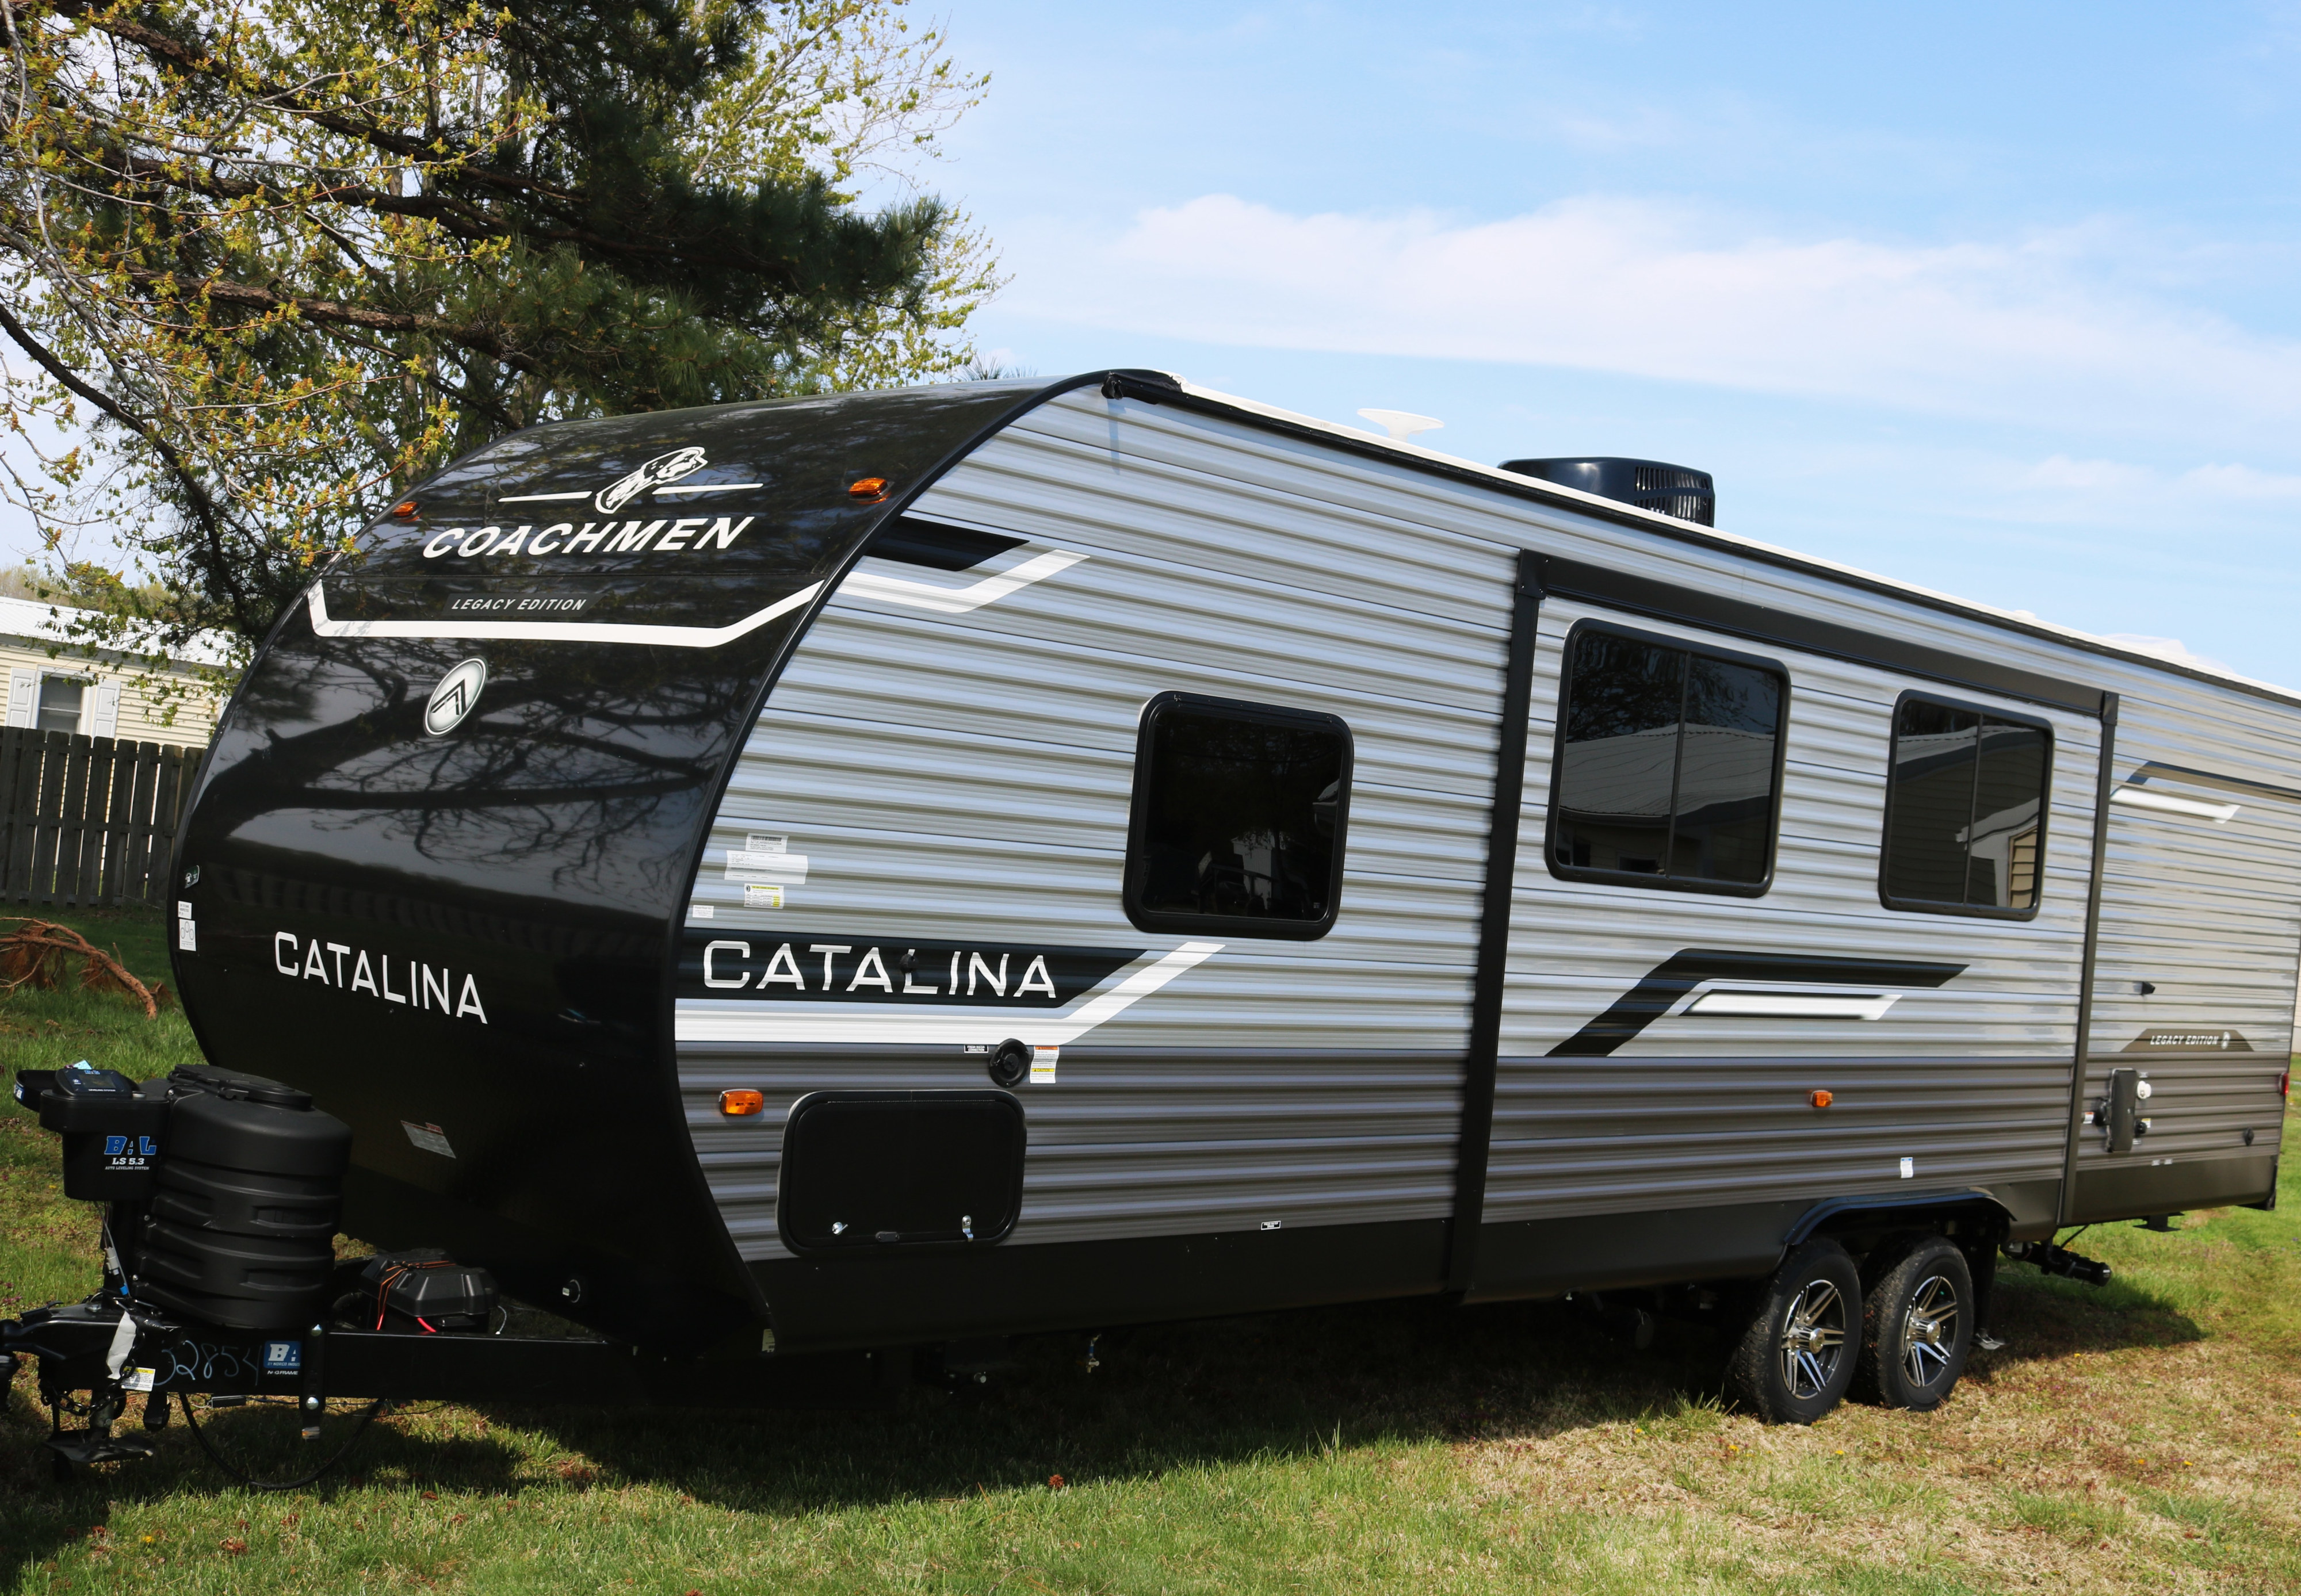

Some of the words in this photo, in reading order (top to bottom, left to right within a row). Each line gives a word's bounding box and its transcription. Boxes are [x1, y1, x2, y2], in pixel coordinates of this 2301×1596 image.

[422, 516, 755, 558] COACHMEN
[452, 599, 515, 610] LEGACY
[517, 599, 587, 610] EDITION
[275, 931, 488, 1024] CATALINA
[703, 940, 1057, 999] CATALINA
[2150, 1035, 2184, 1045] LEGACY
[2185, 1036, 2219, 1045] EDITION
[104, 1135, 156, 1155] BAL
[112, 1157, 127, 1165] LS
[128, 1157, 144, 1165] 5.3
[268, 1344, 296, 1361] BA
